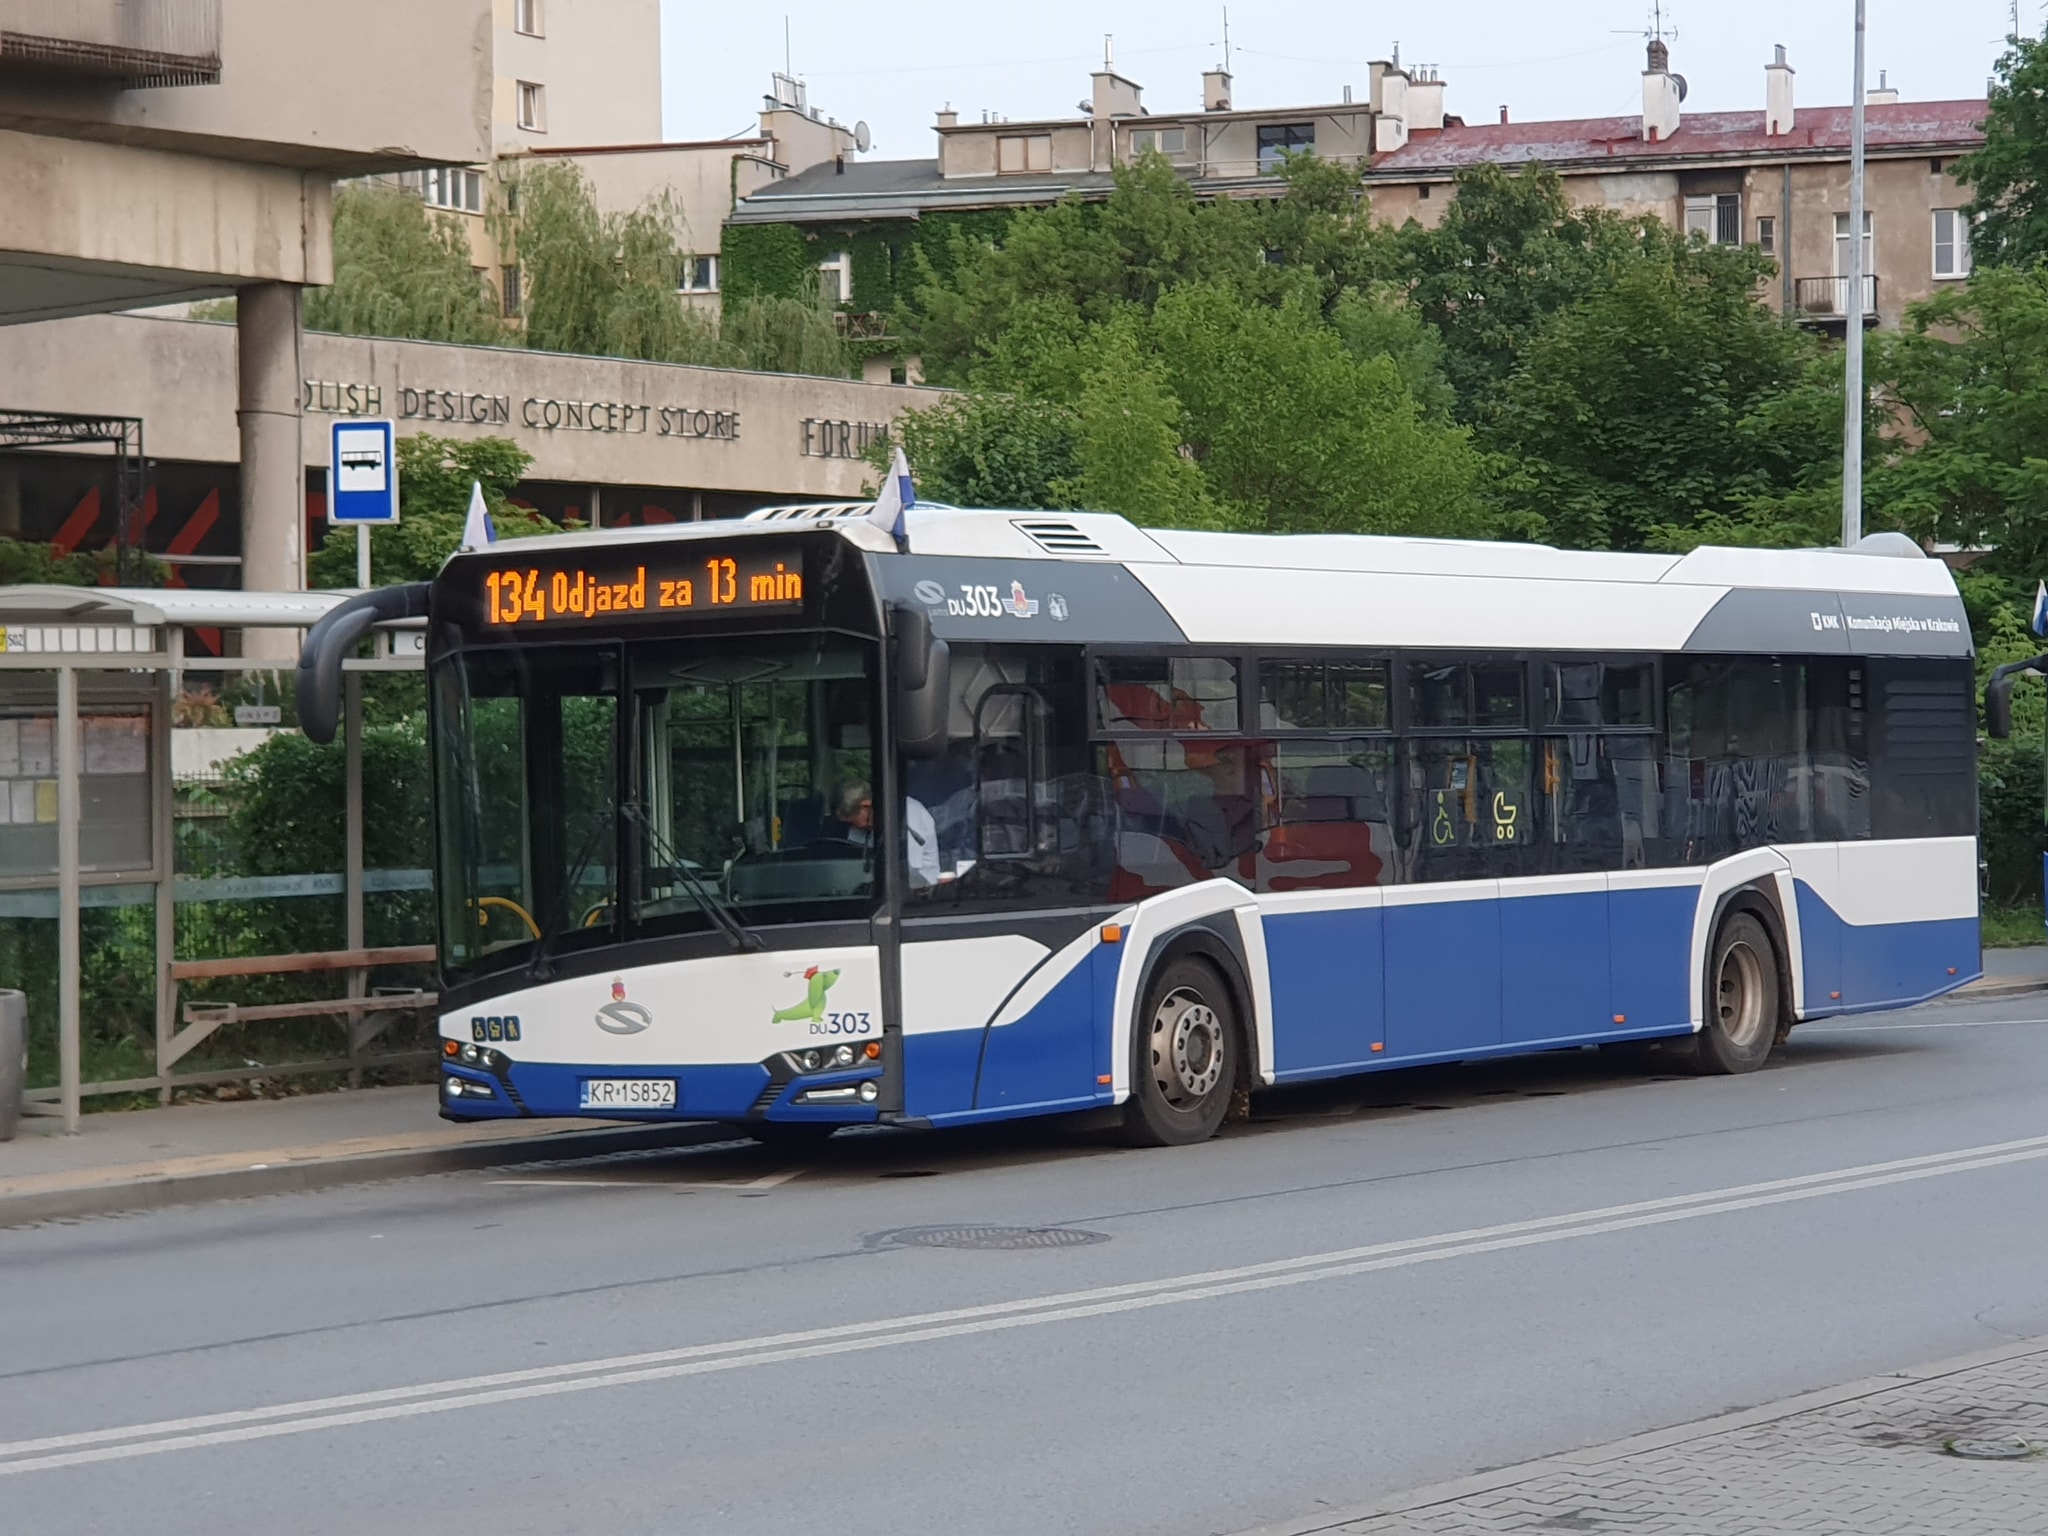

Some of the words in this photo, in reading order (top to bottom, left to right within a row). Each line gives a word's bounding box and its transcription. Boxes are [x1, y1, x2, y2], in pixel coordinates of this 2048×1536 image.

[402, 388, 510, 423] DESIGN
[522, 398, 652, 432] CONCEPT
[660, 406, 741, 440] STORE
[485, 567, 546, 624] 134
[551, 565, 646, 619] Odjazd
[658, 579, 693, 607] za
[705, 557, 737, 604] 13
[750, 562, 803, 602] min
[591, 1082, 615, 1103] KR
[622, 1082, 672, 1103] 1S852
